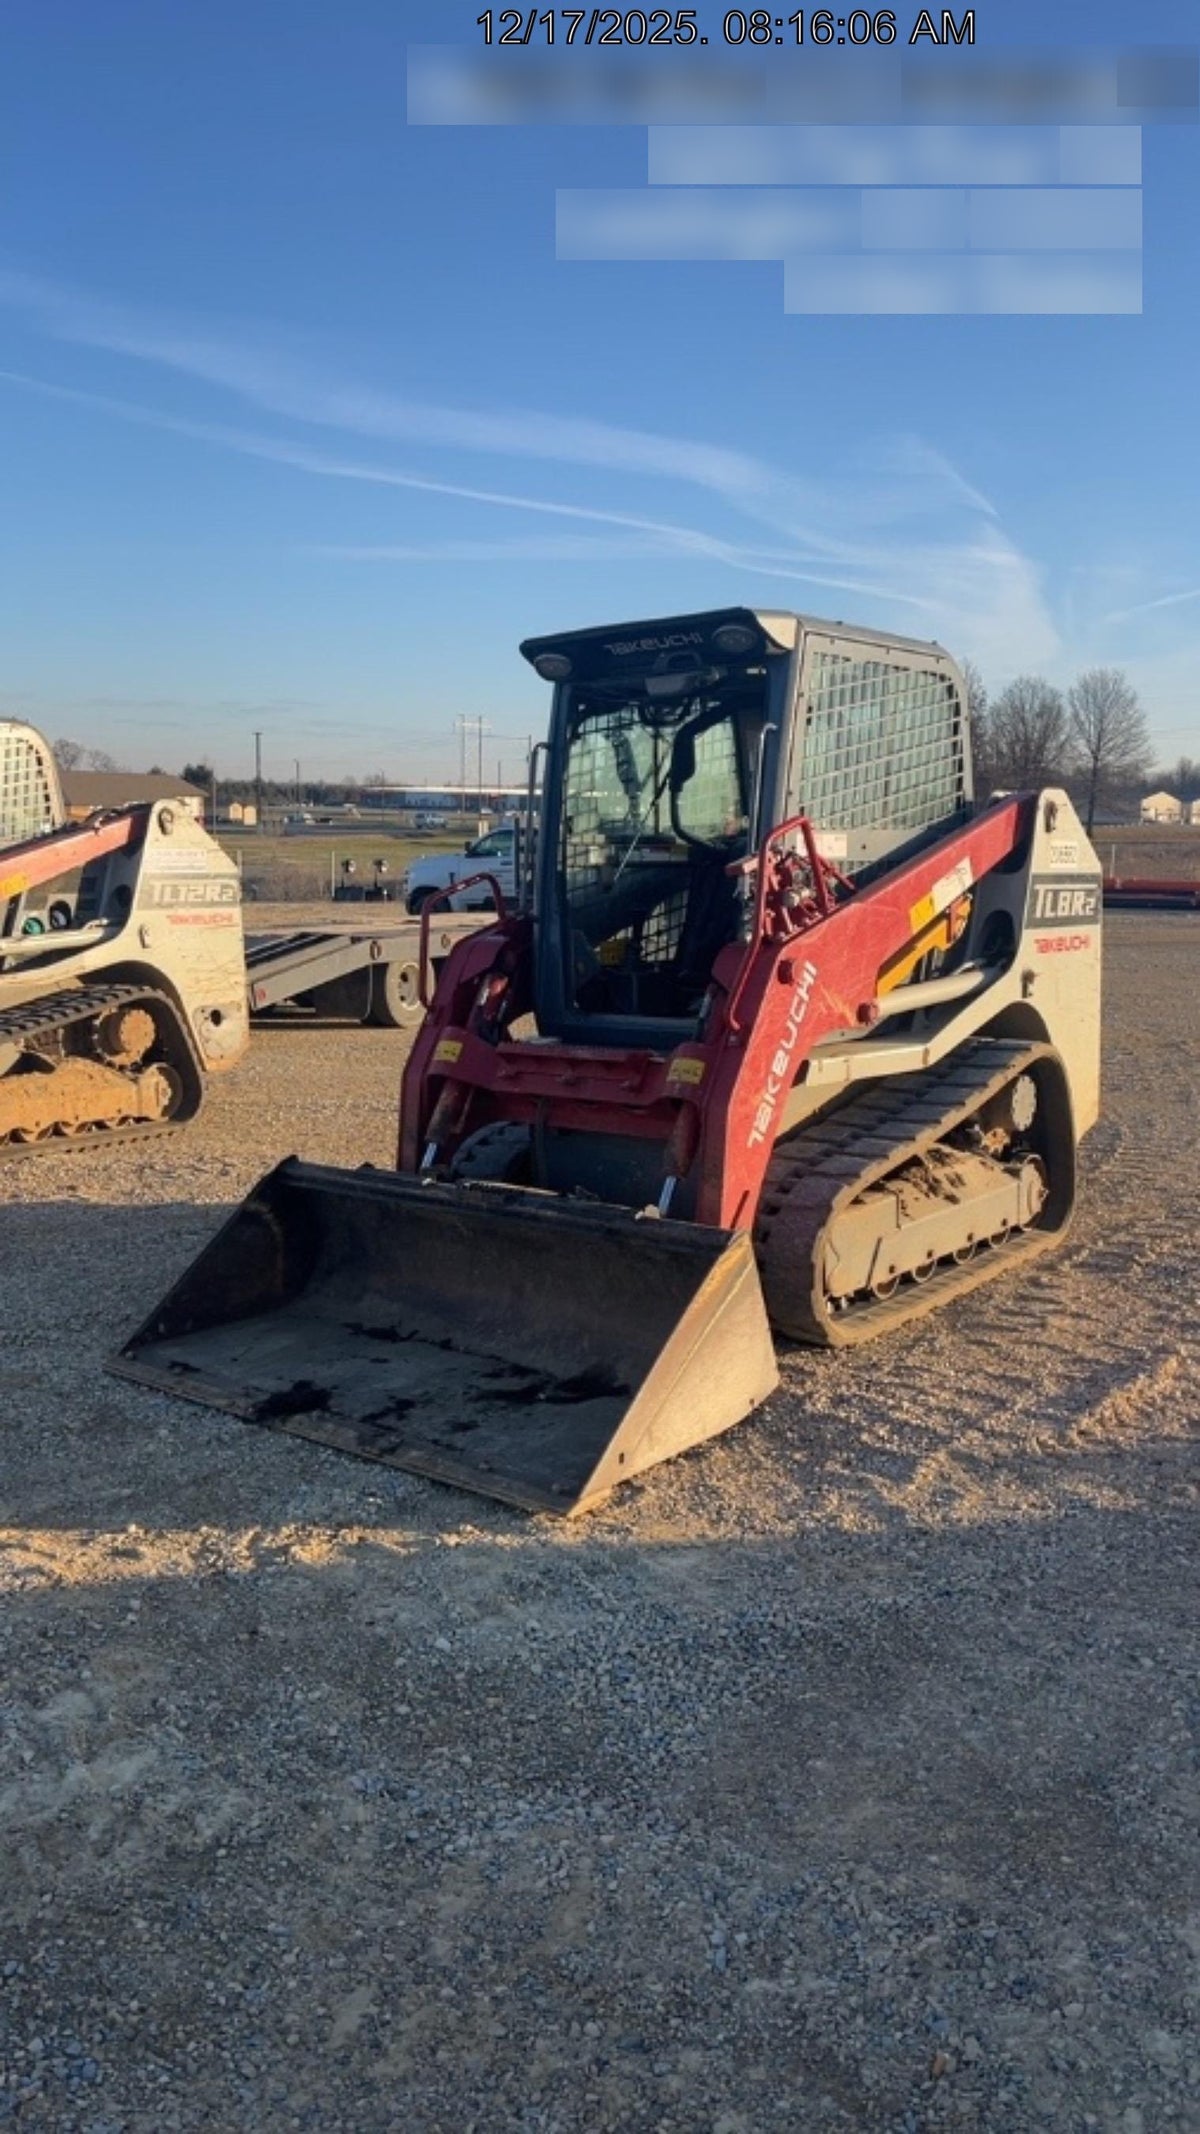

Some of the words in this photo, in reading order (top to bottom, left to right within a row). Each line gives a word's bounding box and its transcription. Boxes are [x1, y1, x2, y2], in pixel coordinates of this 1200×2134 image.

[603, 632, 703, 656] TAKEUCHI
[1034, 935, 1090, 953] TAKEUCHI
[747, 961, 817, 1147] TAKEUCHI
